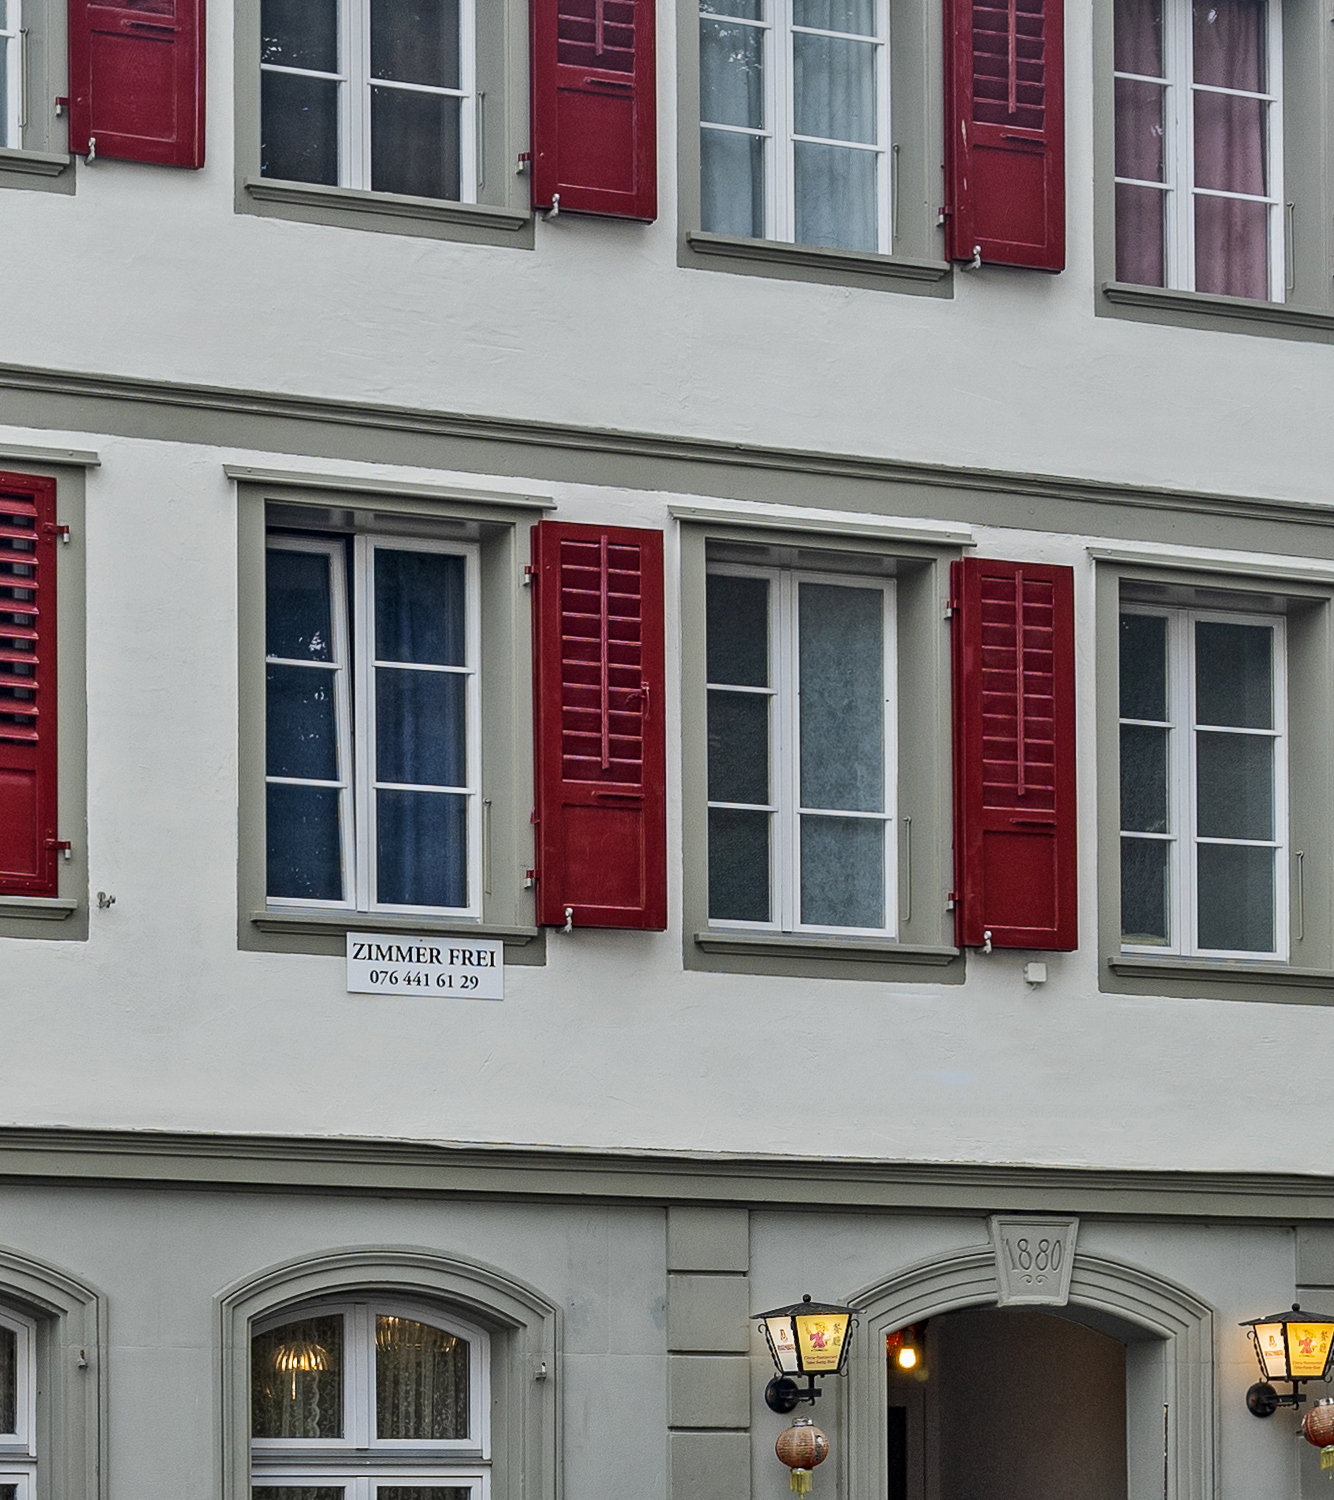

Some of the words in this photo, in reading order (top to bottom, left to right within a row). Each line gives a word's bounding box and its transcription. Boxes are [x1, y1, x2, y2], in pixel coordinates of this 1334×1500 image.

[352, 942, 443, 965] ZIMMER
[449, 948, 496, 968] FREI
[369, 969, 399, 986] 076
[403, 971, 430, 987] 441
[436, 972, 454, 989] 61
[459, 974, 479, 991] 29
[1002, 1238, 1062, 1272] 1880
